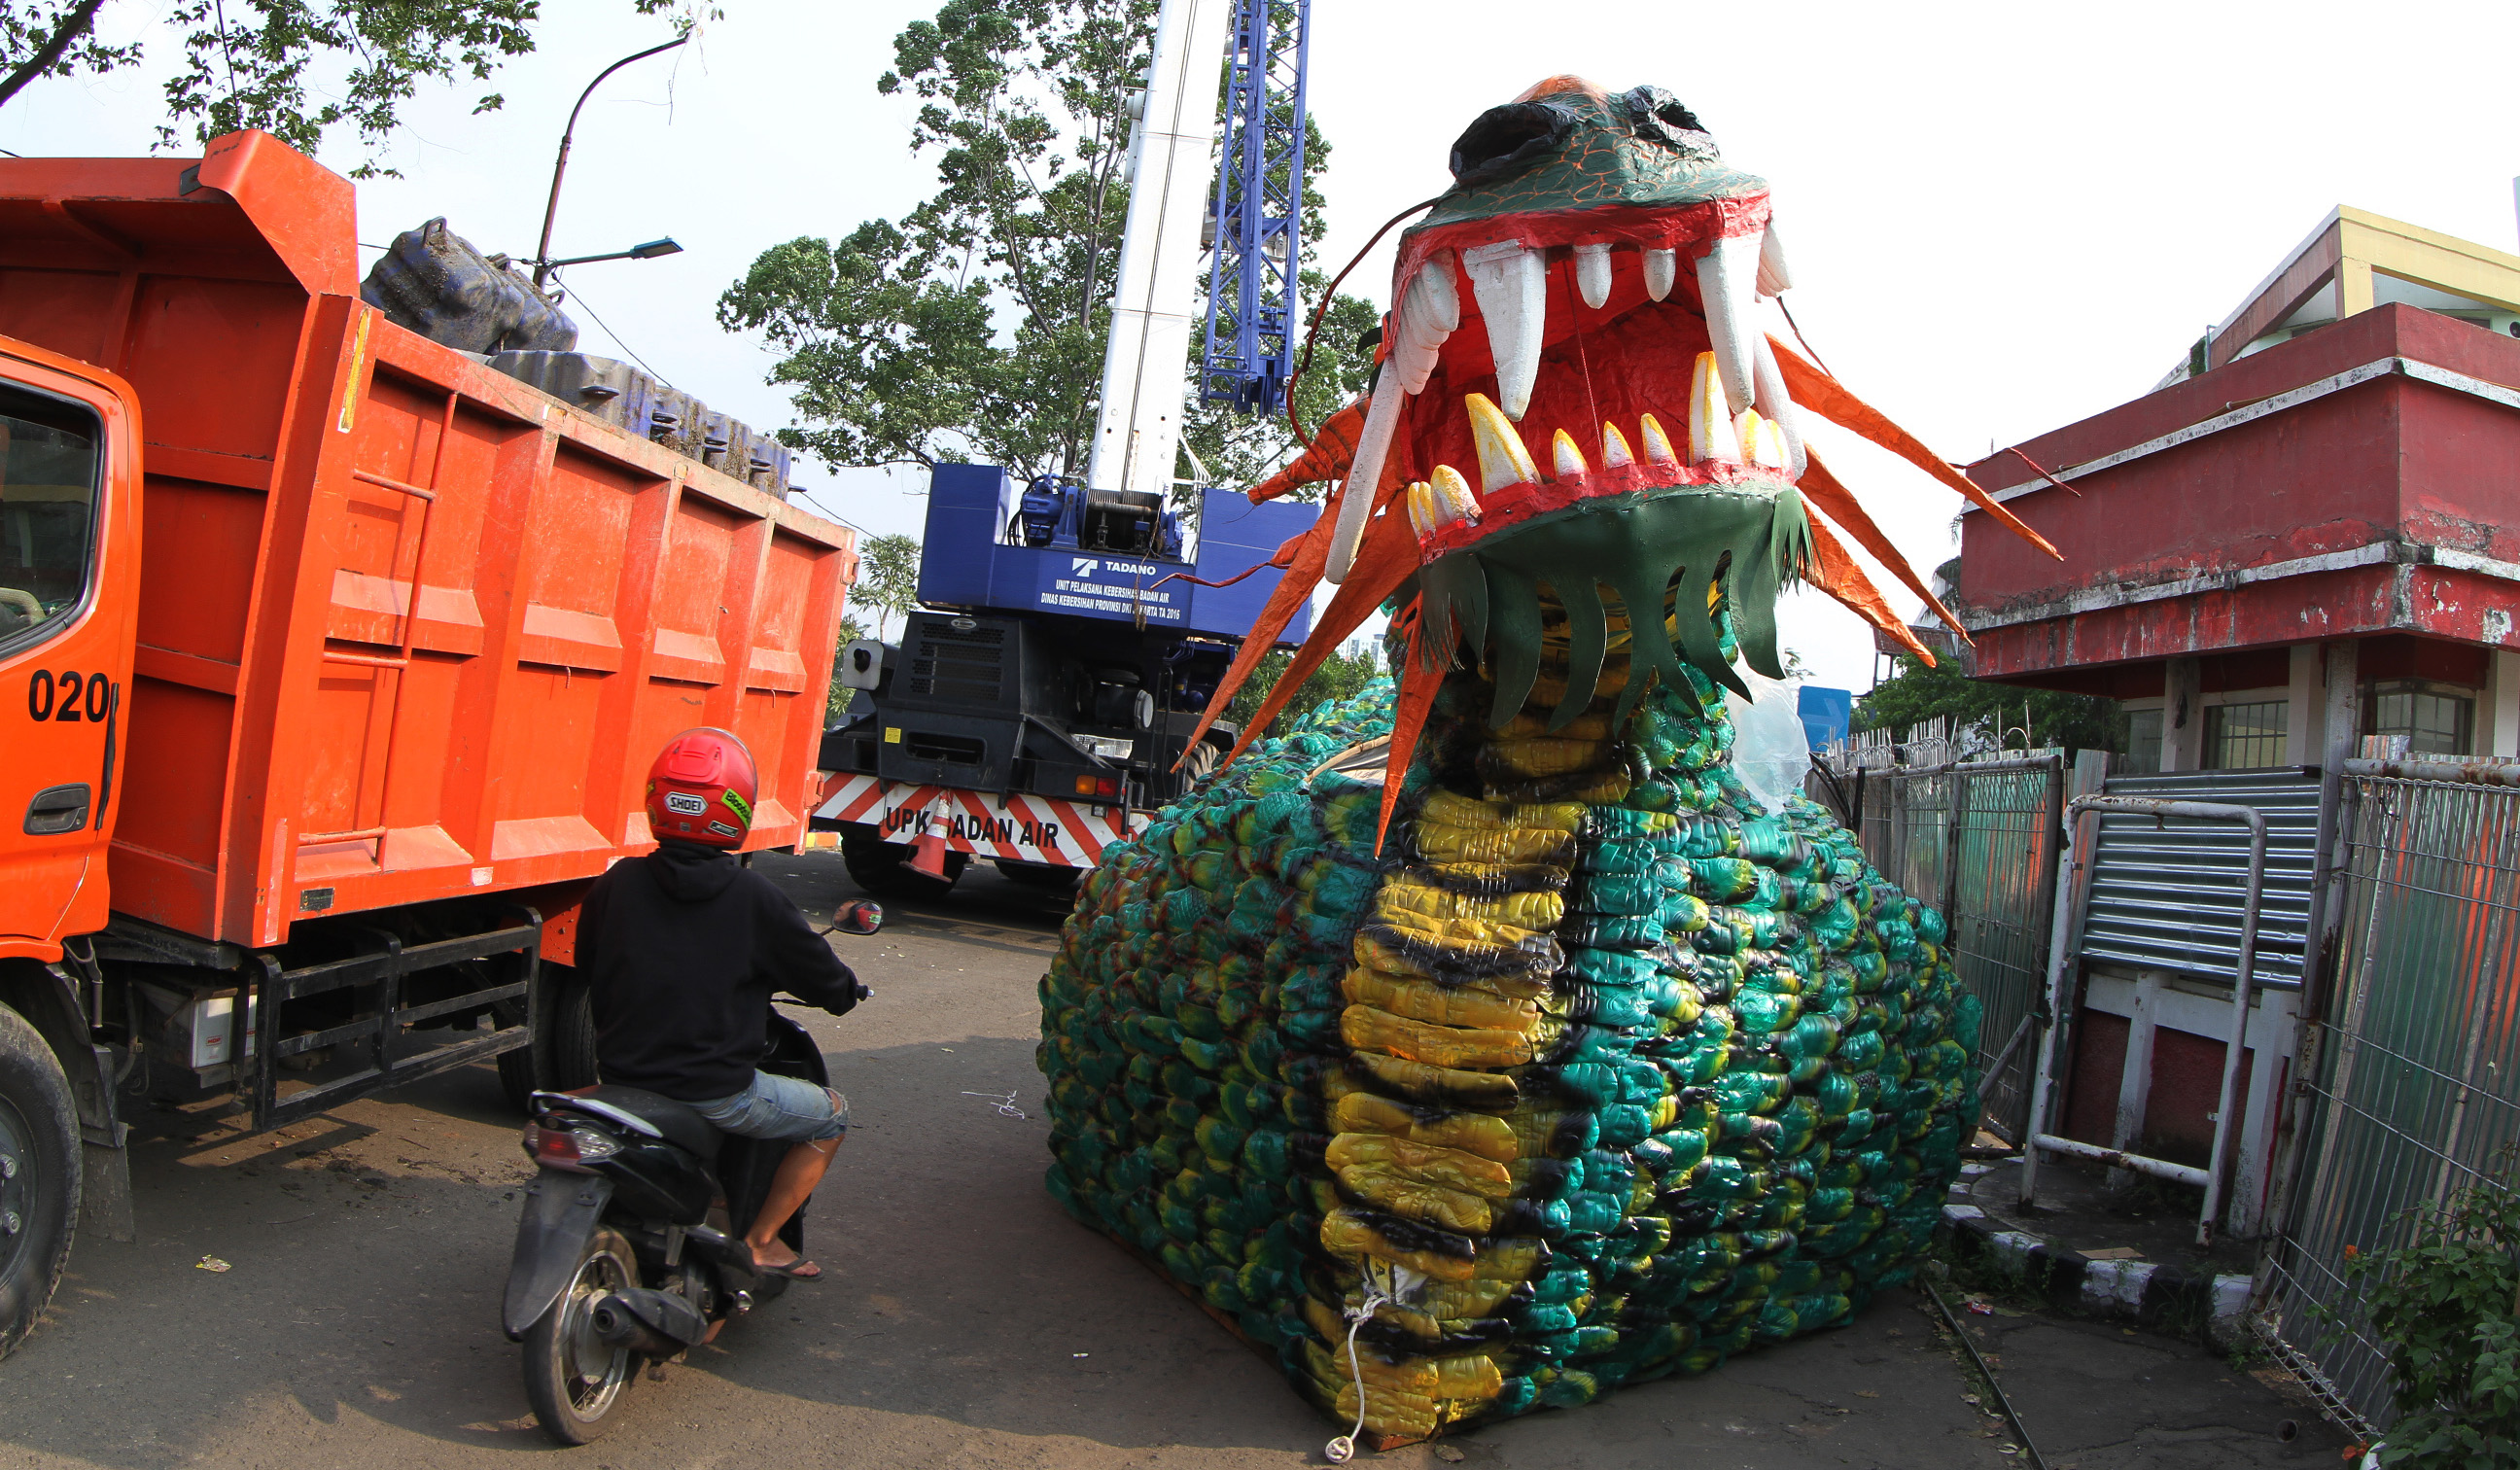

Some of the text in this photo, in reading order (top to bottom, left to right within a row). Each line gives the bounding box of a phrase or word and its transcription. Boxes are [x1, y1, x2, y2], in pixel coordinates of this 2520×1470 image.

[1105, 561, 1157, 576] TADANO
[1056, 578, 1069, 590] UNIT
[1069, 580, 1102, 596] PELAKSANA
[1139, 590, 1159, 603] BADAN
[1159, 593, 1170, 604] AIR
[1040, 592, 1059, 605] DINAS
[1059, 594, 1095, 610] KEBERSIHAN
[1095, 599, 1121, 612] PROVINSI
[1122, 603, 1133, 613] DKI
[1158, 608, 1166, 618] TA
[1167, 609, 1180, 620] 2016
[29, 669, 110, 722] 020
[670, 797, 701, 812] SHOEI
[886, 806, 1059, 849] UPK ADAN AIR
